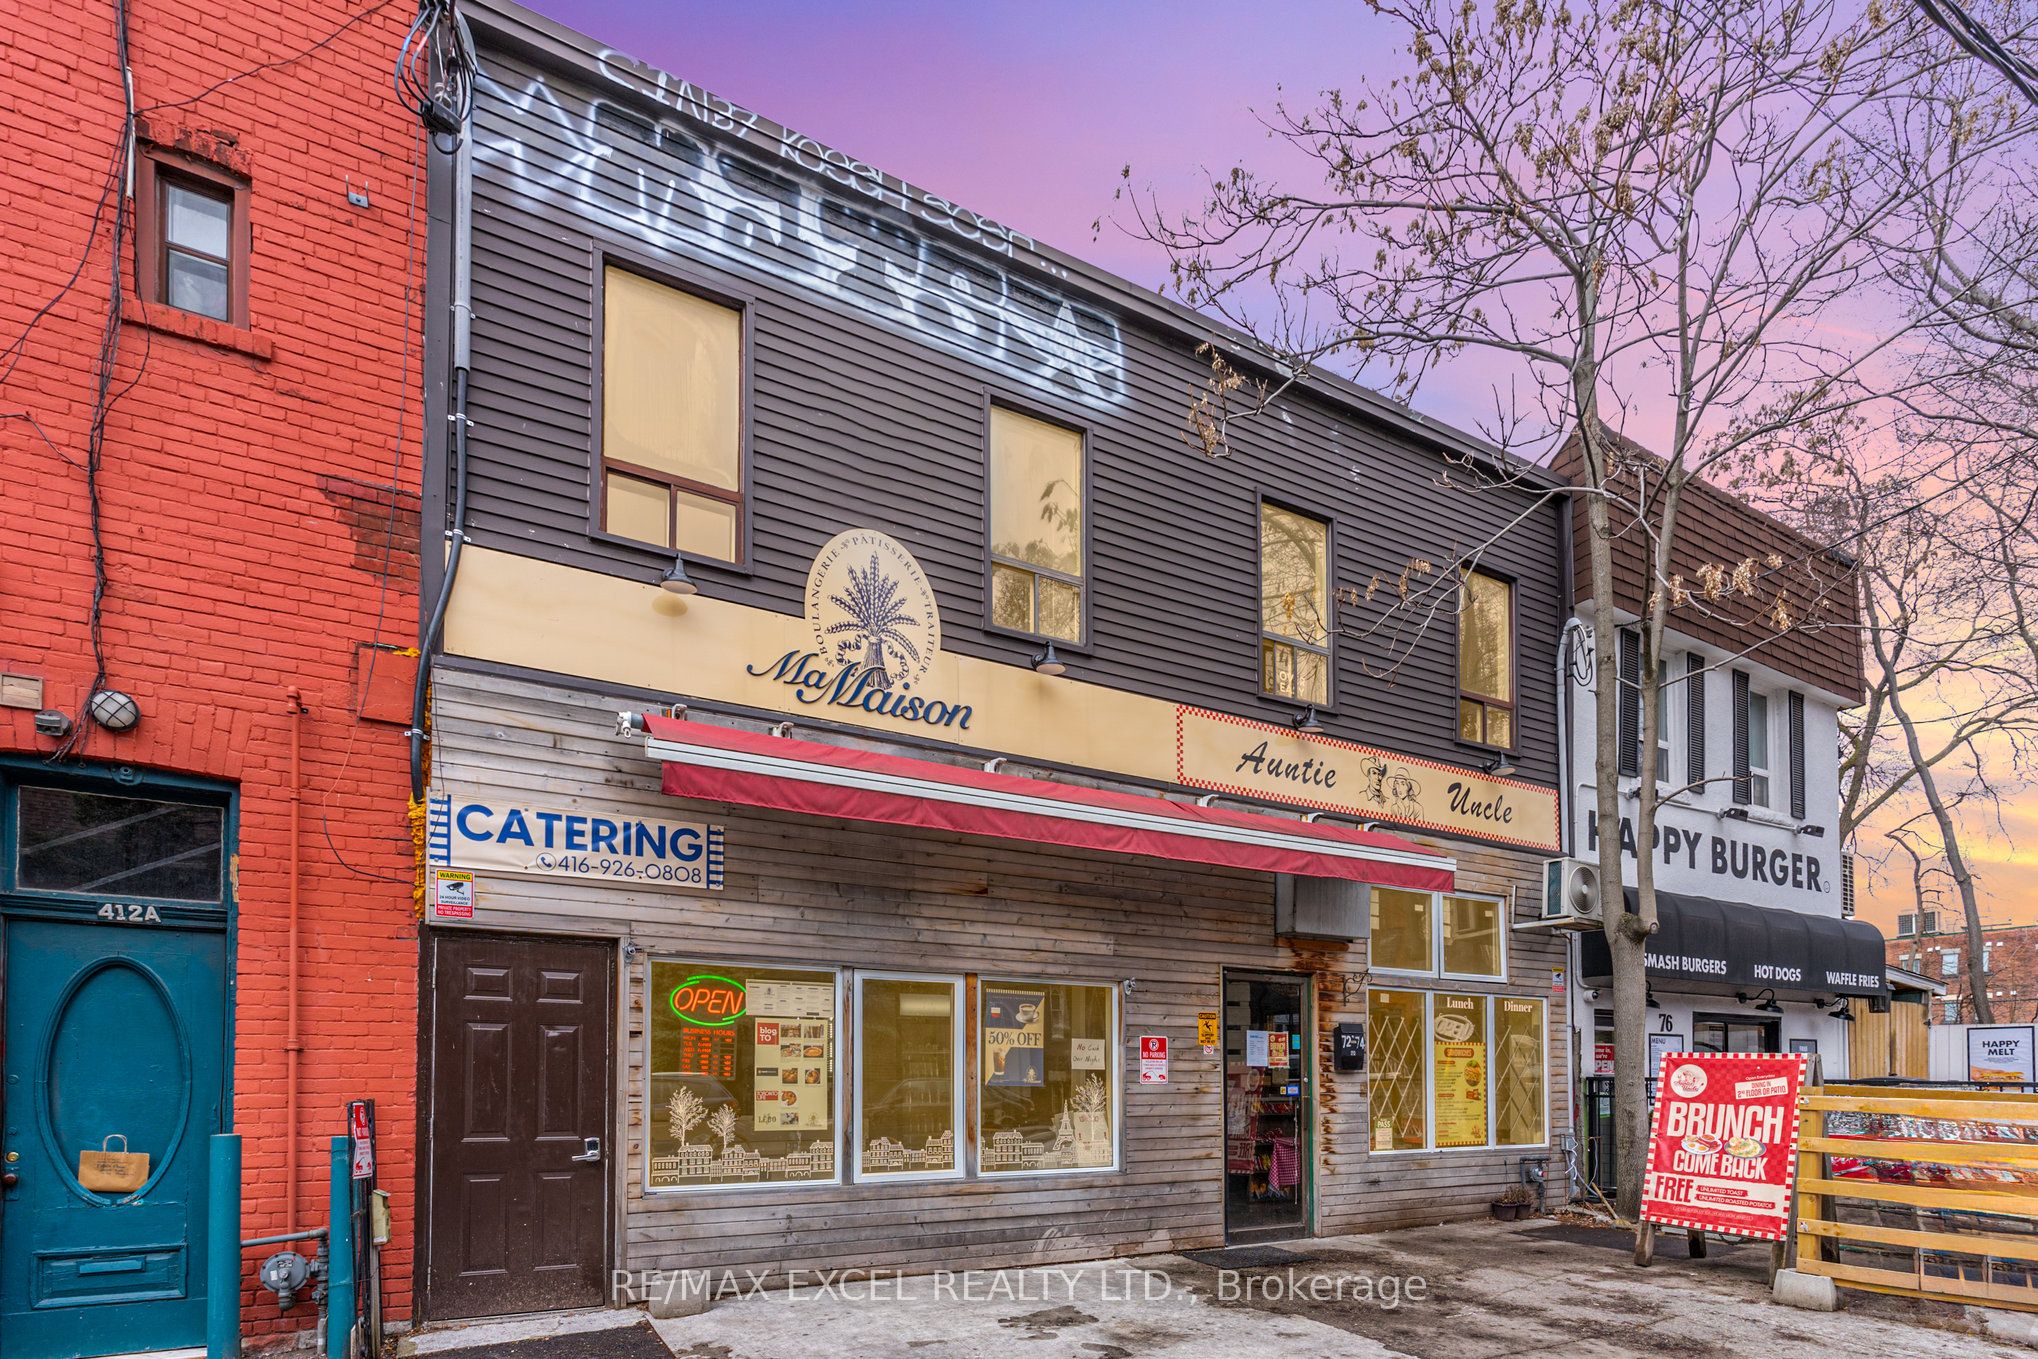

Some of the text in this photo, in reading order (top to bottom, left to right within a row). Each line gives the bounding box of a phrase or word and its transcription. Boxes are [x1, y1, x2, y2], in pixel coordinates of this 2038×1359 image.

[811, 548, 840, 655] BOULANGERIE
[919, 602, 934, 673] TRAITEUR
[1235, 741, 1513, 824] Auntie Uncle
[456, 804, 703, 862] CATERING
[558, 855, 702, 884] 416-926-0808
[1711, 835, 1823, 893] BURGER
[439, 872, 470, 880] WARNING
[98, 903, 162, 923] 412A
[1644, 952, 1727, 975] SMASH BURGERS
[1754, 964, 1802, 982] HOT DOGS
[1826, 971, 1880, 988] WAFFLE FRIES
[674, 987, 745, 1014] OPEN
[1446, 997, 1474, 1010] Lunch
[1504, 1001, 1532, 1013] Dinner
[760, 1026, 778, 1036] blog
[1658, 1014, 1673, 1032] 76
[988, 1031, 1042, 1046] 50% OFF
[1982, 1040, 2020, 1048] HAPPY
[1150, 1052, 1166, 1060] PARKING
[1988, 1048, 2015, 1056] MELT
[1746, 1088, 1762, 1098] FLOOR
[1763, 1087, 1770, 1096] OR
[1378, 1120, 1390, 1128] PASS
[1666, 1101, 1784, 1144] BRUNCH
[1673, 1150, 1768, 1181] COME BACK
[1654, 1174, 1694, 1203] FREE
[1700, 1186, 1726, 1194] UNLIMITED
[1699, 1194, 1725, 1204] UNLIMITED
[1725, 1198, 1749, 1206] ROASTED
